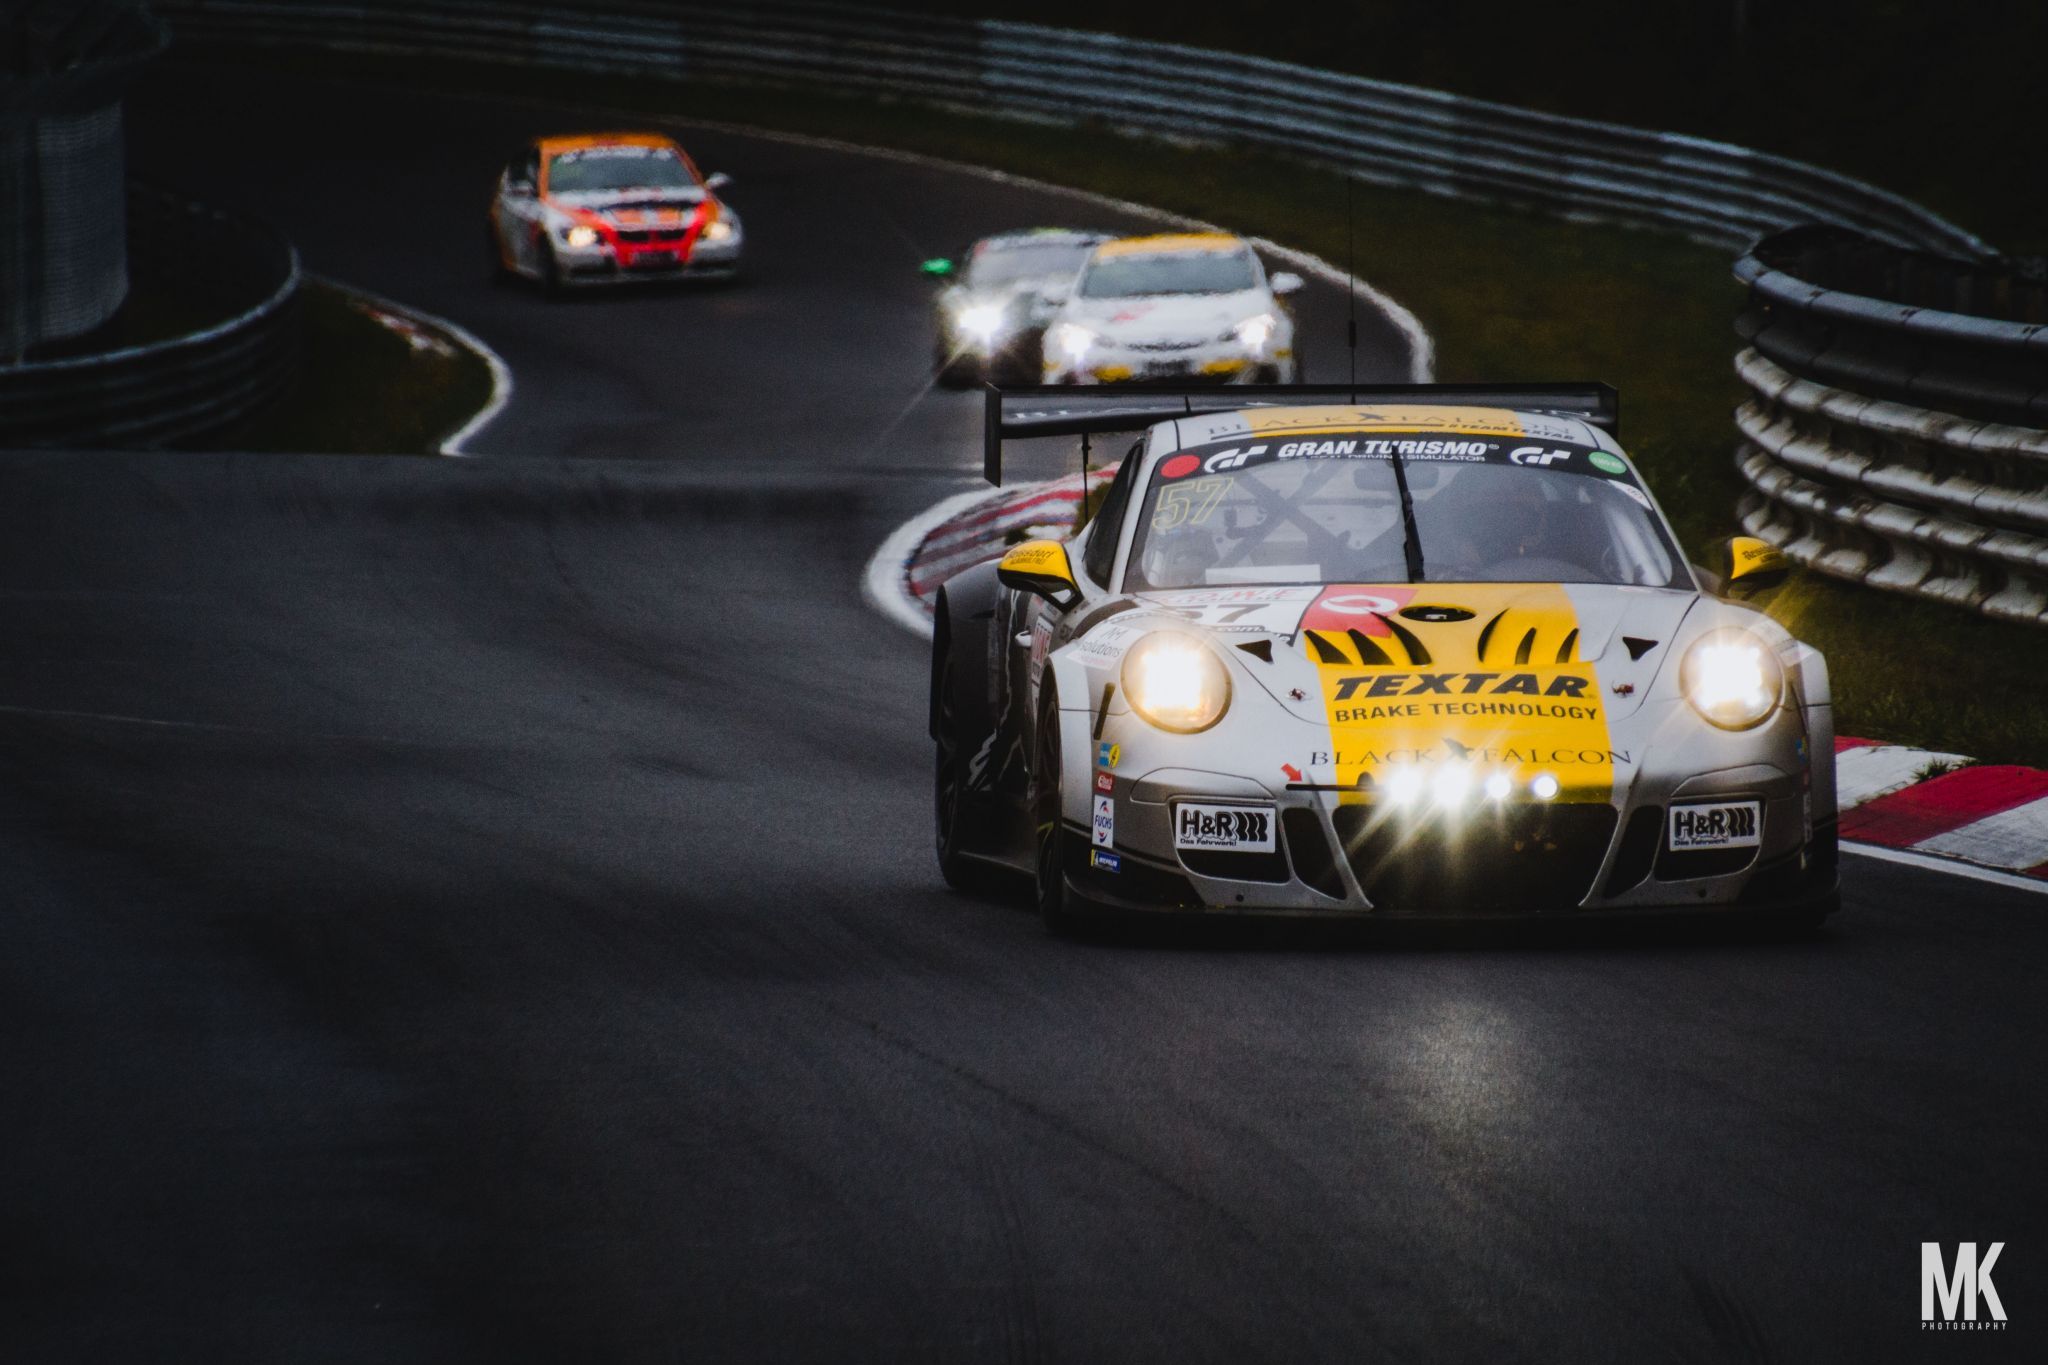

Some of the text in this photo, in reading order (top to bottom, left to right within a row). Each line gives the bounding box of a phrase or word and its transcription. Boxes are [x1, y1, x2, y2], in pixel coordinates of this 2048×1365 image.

[1278, 440, 1358, 457] GRAN
[1406, 454, 1486, 462] SIMULATOR
[1151, 477, 1235, 530] 57
[1078, 640, 1122, 658] solutions
[1334, 673, 1589, 700] TEXTAR
[1335, 702, 1597, 722] BRAKE TECHNOLOGY
[1310, 748, 1632, 766] BLACK FALCON
[1094, 814, 1113, 830] FUCHS
[1180, 809, 1238, 840] H&R
[1674, 809, 1728, 839] H&R
